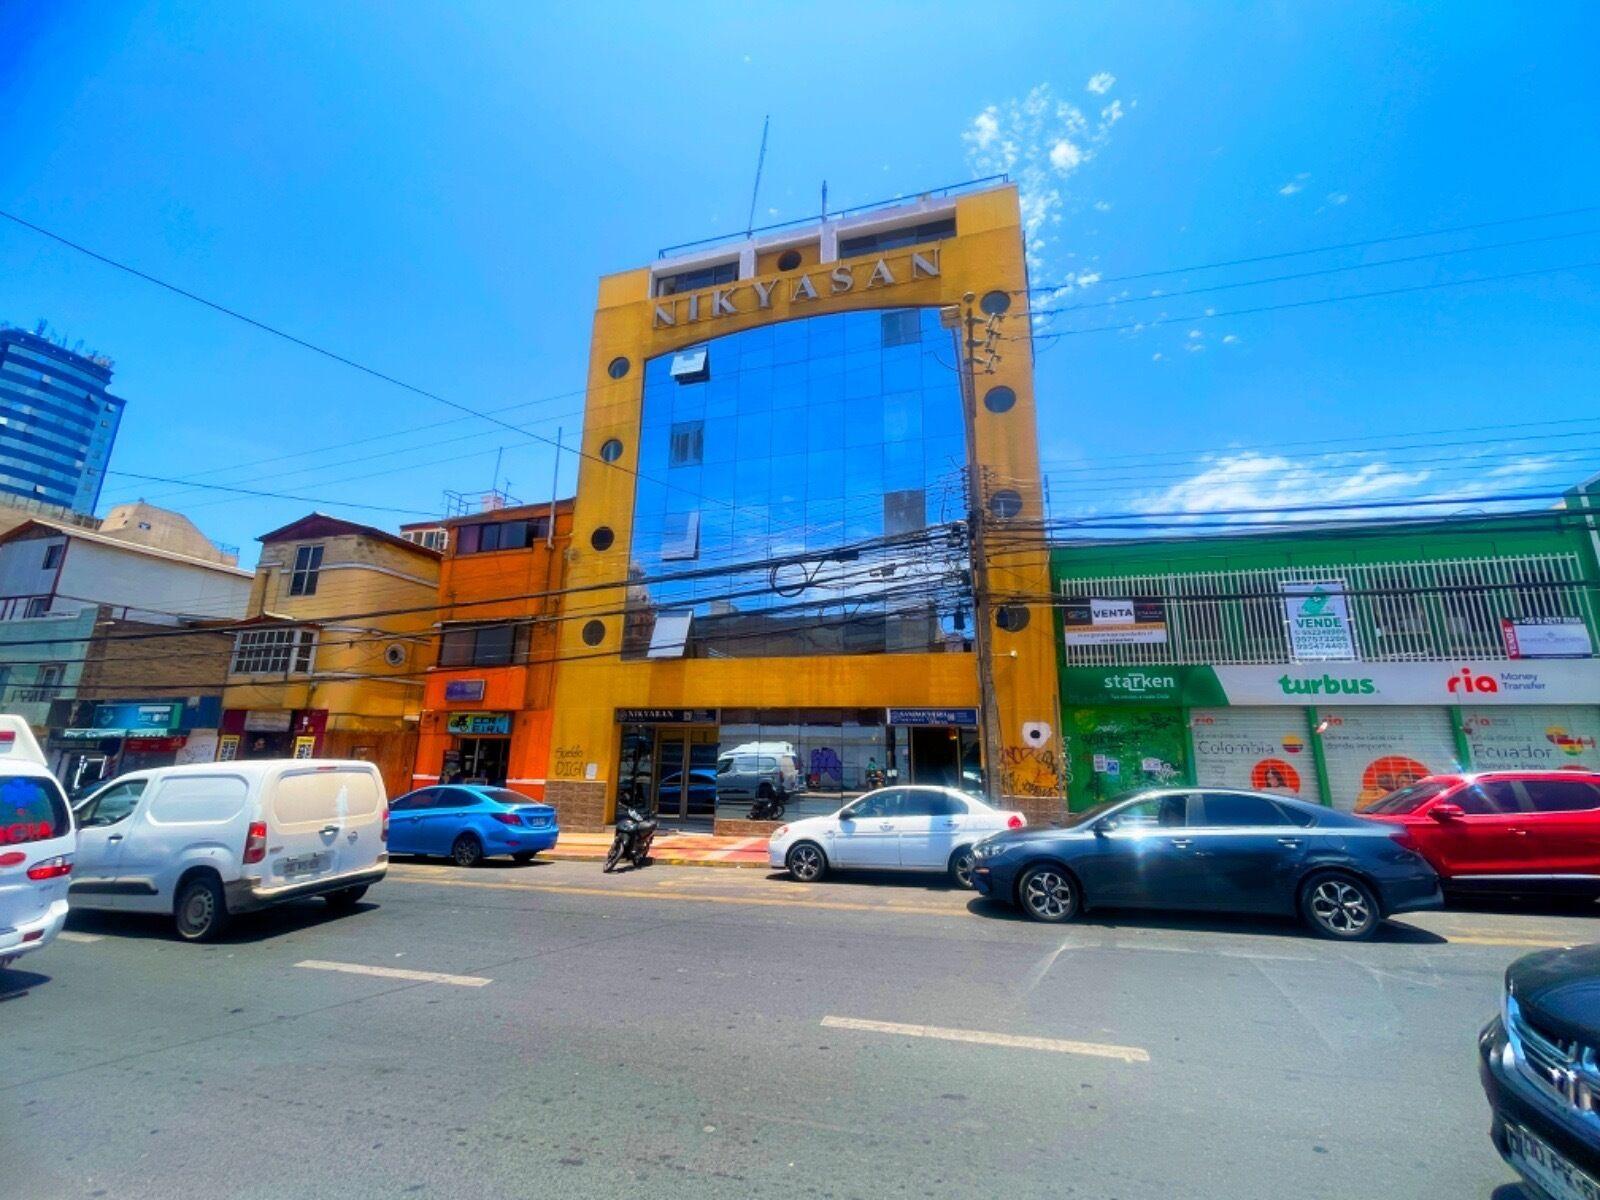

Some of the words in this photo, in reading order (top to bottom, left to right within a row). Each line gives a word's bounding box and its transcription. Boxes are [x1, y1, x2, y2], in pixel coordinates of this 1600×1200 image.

[653, 247, 941, 329] NIKYASAN
[1093, 608, 1133, 618] VENTA
[1296, 617, 1342, 628] VENDE
[1104, 673, 1174, 691] starken
[1447, 667, 1498, 692] ria
[1501, 672, 1538, 681] Money
[1503, 681, 1546, 690] Transfer
[1198, 740, 1274, 754] Colombia
[1472, 743, 1553, 759] Ecuador
